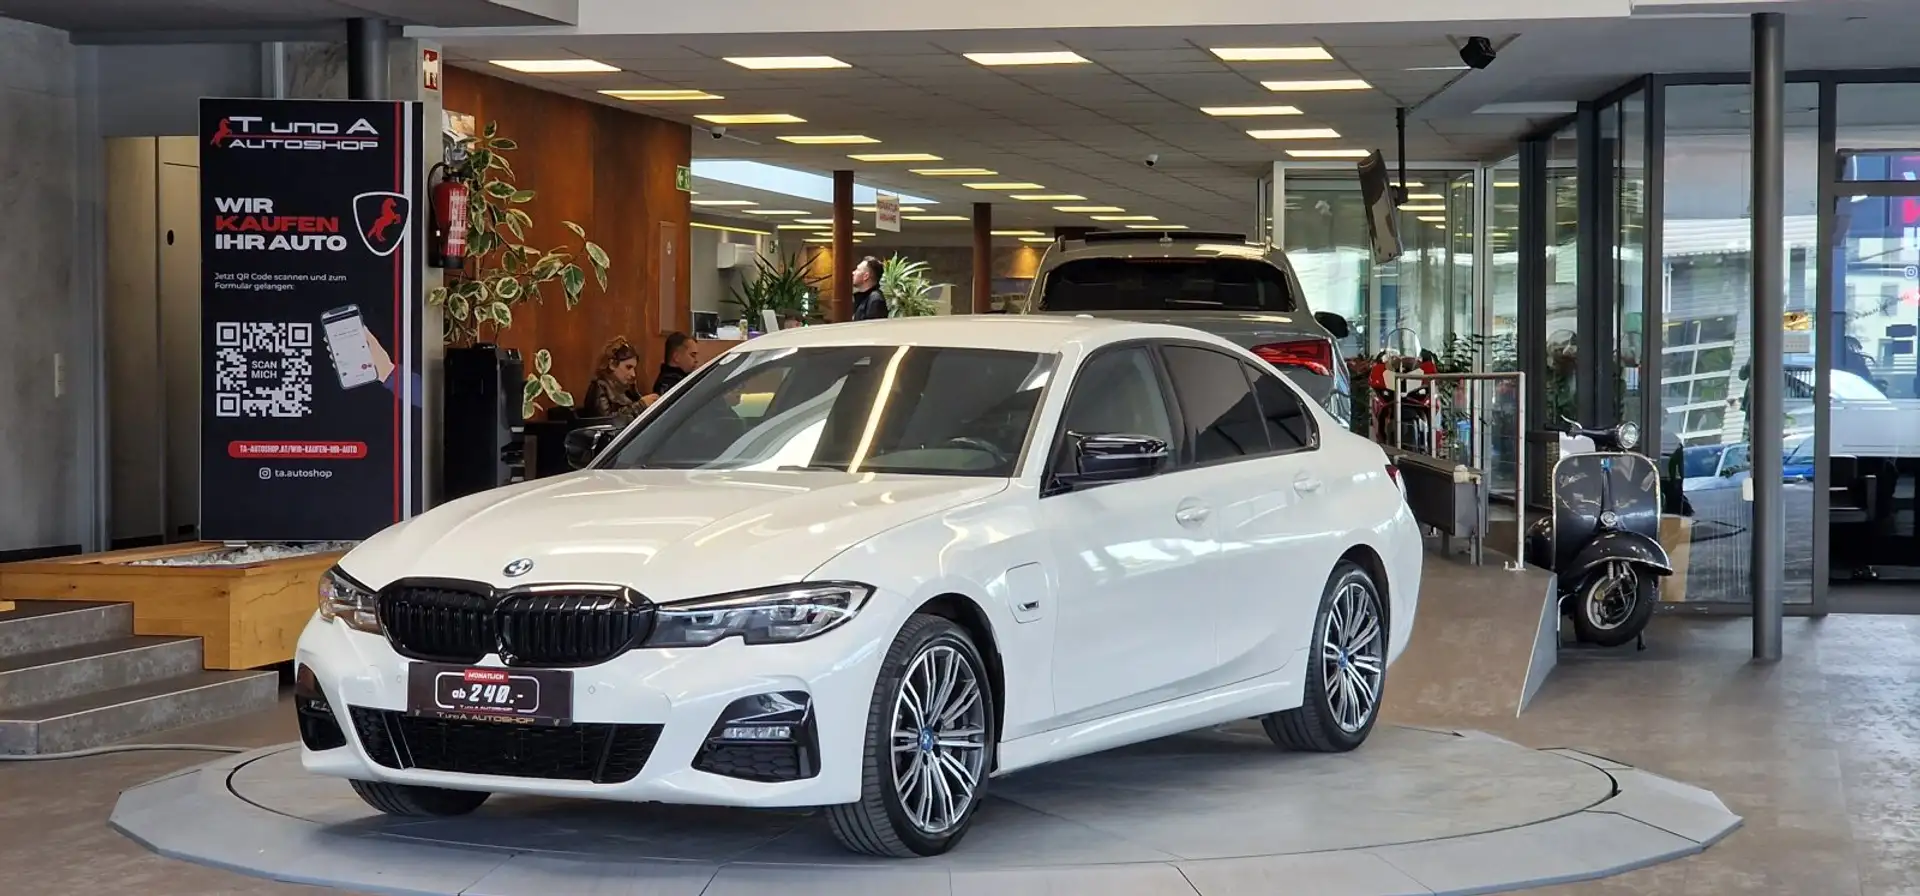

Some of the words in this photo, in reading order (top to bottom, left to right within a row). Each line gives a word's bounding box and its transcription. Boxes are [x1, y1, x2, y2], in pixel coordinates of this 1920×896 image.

[229, 116, 262, 132] T
[346, 118, 378, 134] A
[228, 139, 379, 150] AUTOSHOP
[214, 197, 273, 213] WIR
[214, 216, 339, 232] KAUFEN
[215, 234, 266, 250] IHR
[268, 235, 347, 251] AUTO
[214, 272, 234, 280] Jetzt
[236, 273, 249, 281] QR
[250, 273, 272, 281] Code
[310, 273, 327, 281] und
[251, 360, 277, 369] SCAN
[251, 370, 277, 379] MICH
[274, 469, 333, 479] ta.autoshop
[468, 672, 505, 680] MONATLICH
[452, 688, 467, 699] ab
[472, 715, 534, 723] AUTOSHOP
